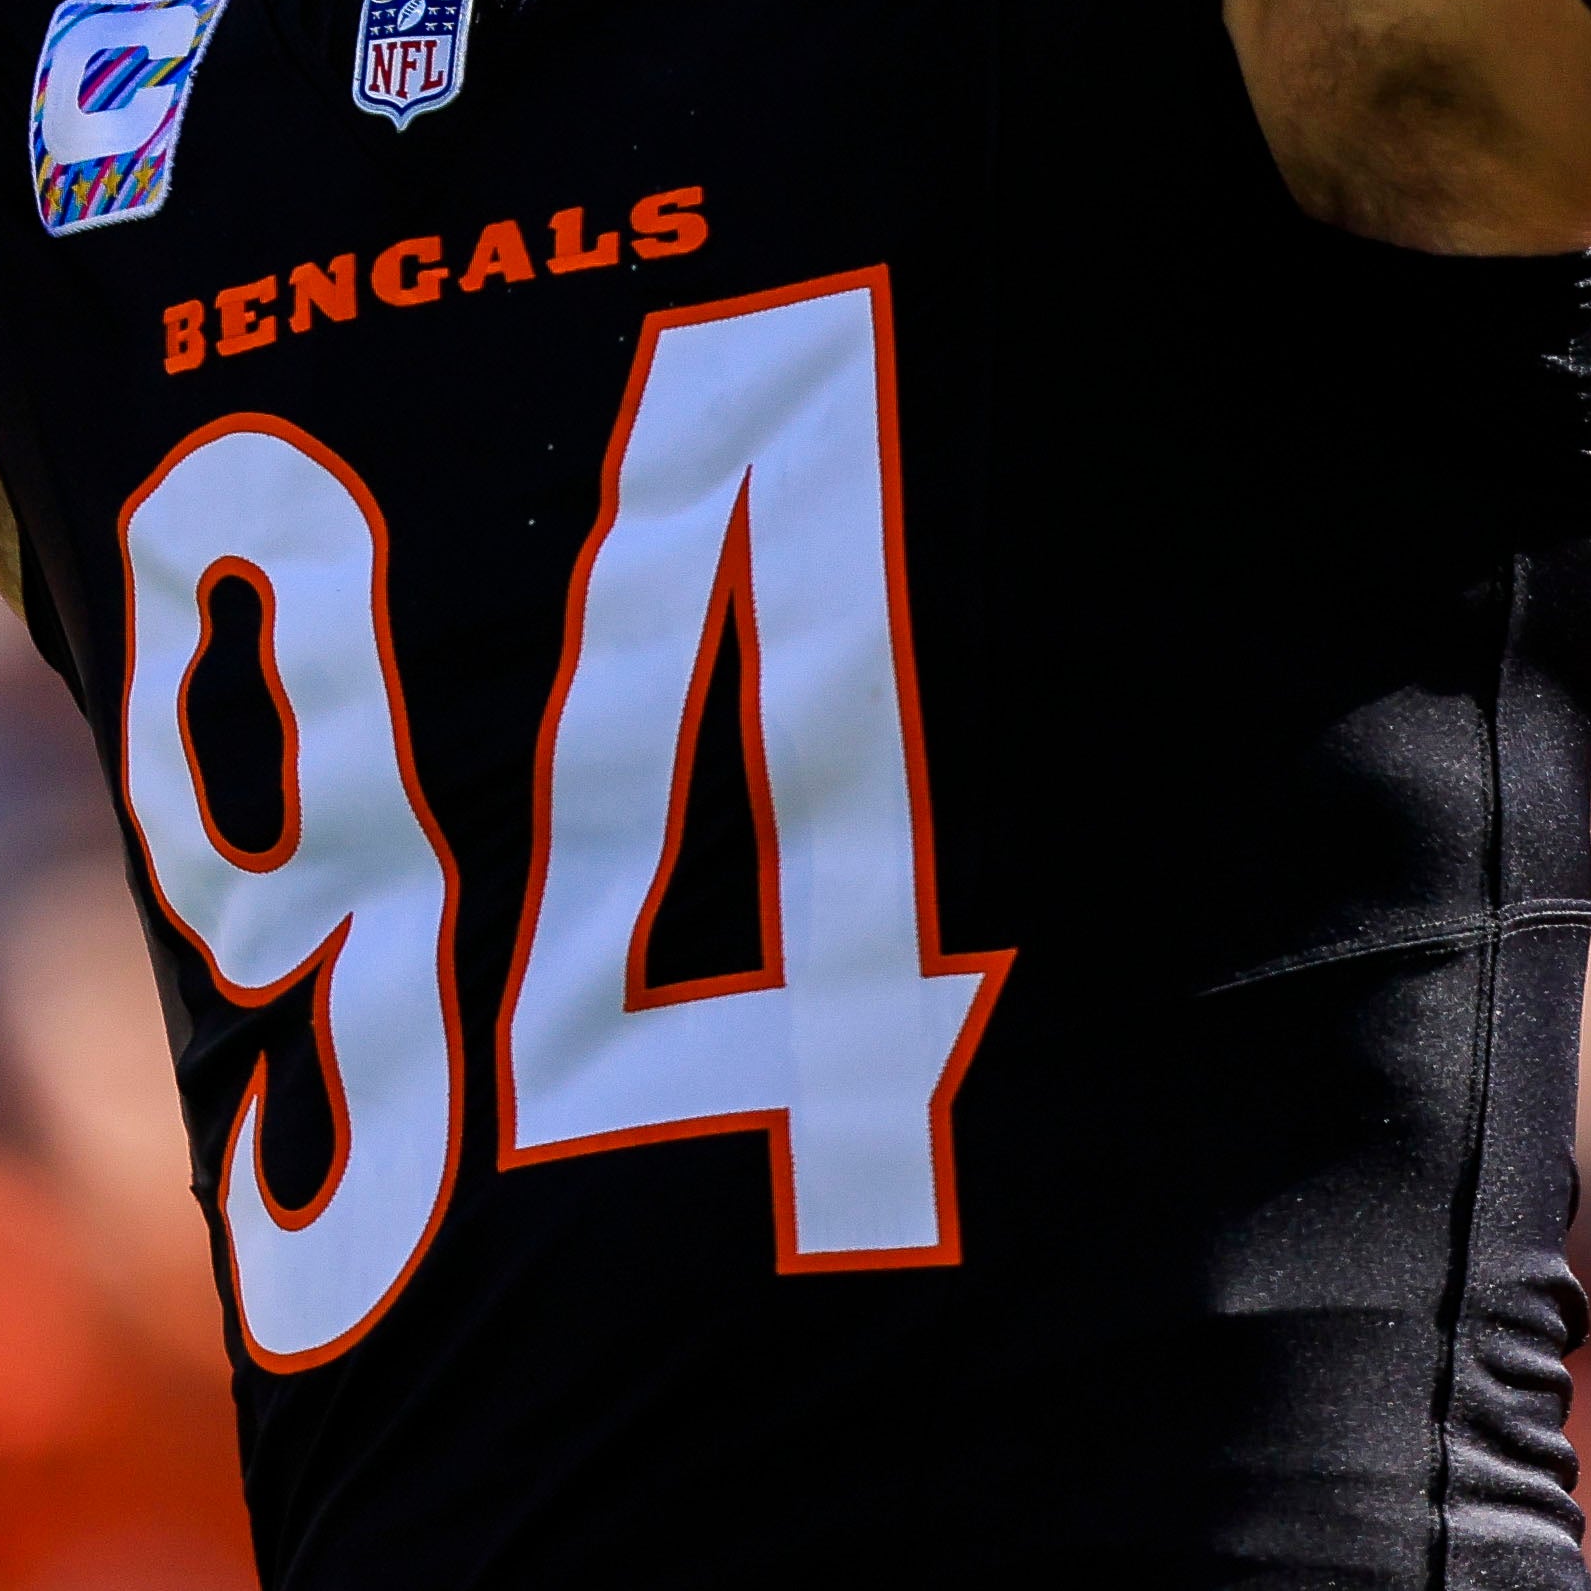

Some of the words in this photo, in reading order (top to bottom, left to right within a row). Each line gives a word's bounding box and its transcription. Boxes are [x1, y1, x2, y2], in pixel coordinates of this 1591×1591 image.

[41, 5, 199, 166] C
[368, 38, 444, 99] NFL
[163, 185, 709, 376] BENGALS
[117, 263, 1017, 1375] 94
